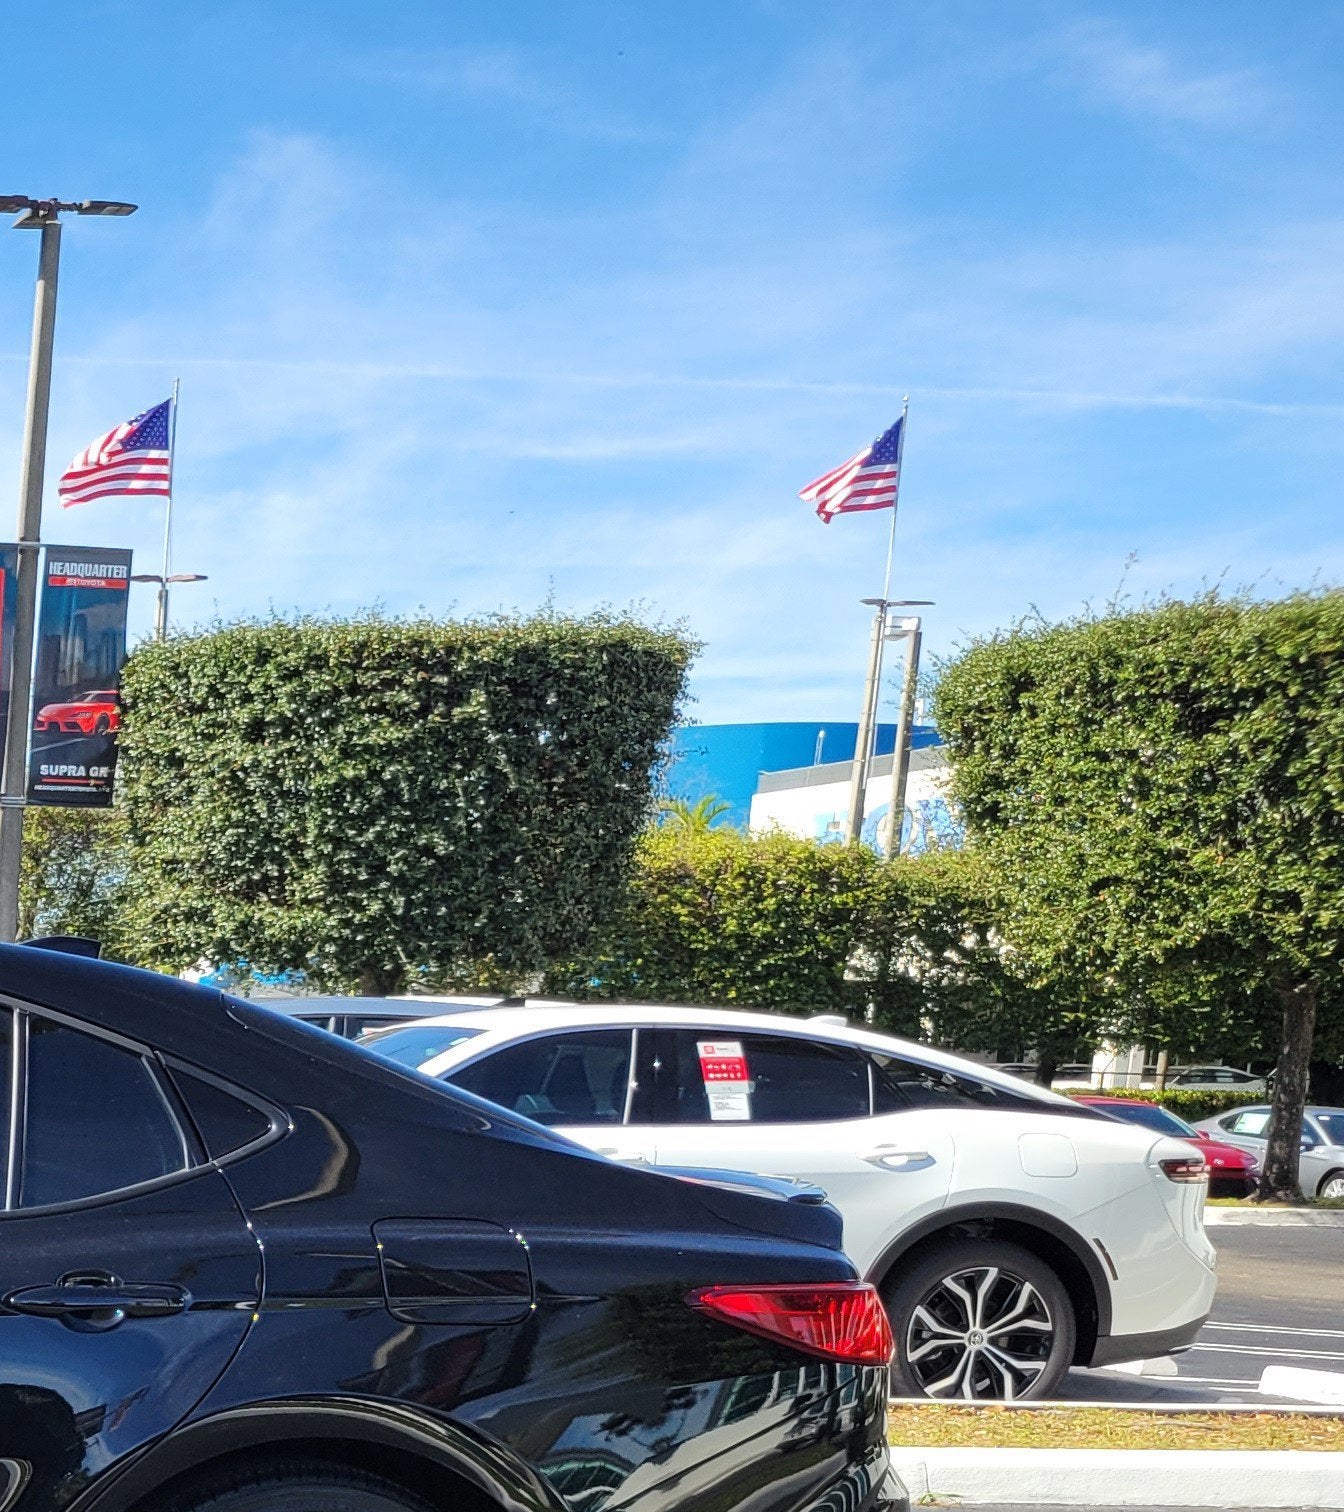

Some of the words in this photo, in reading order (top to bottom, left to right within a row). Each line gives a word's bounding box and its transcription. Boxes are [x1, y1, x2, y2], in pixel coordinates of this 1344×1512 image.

[49, 561, 128, 578] HEADQUARTER
[39, 764, 86, 777] SUPRA
[89, 766, 109, 778] GR
